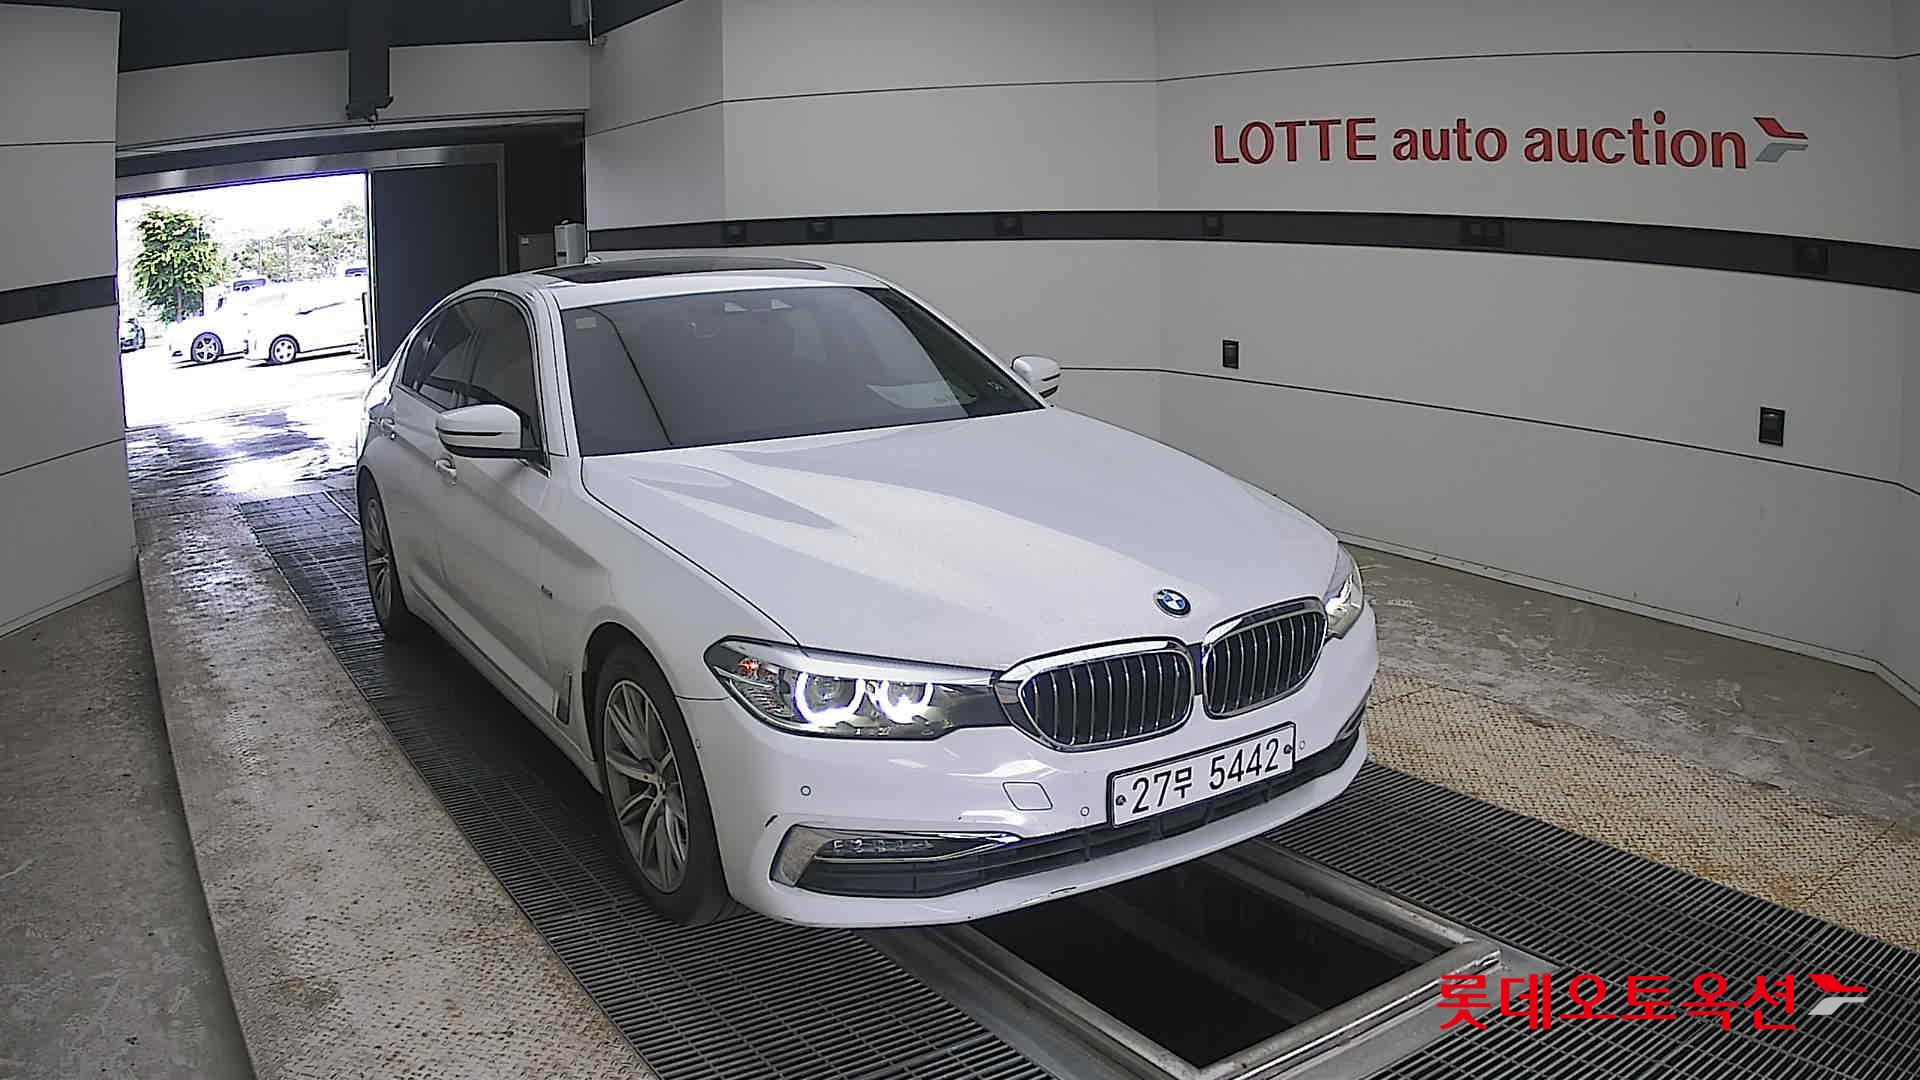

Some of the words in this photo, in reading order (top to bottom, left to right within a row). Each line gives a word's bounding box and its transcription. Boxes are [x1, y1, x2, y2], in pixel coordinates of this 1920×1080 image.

[1214, 118, 1377, 165] LOTTE
[1393, 118, 1507, 162] auto
[1523, 110, 1747, 169] auction
[1132, 767, 1192, 814] 27무
[1209, 738, 1279, 790] 5442
